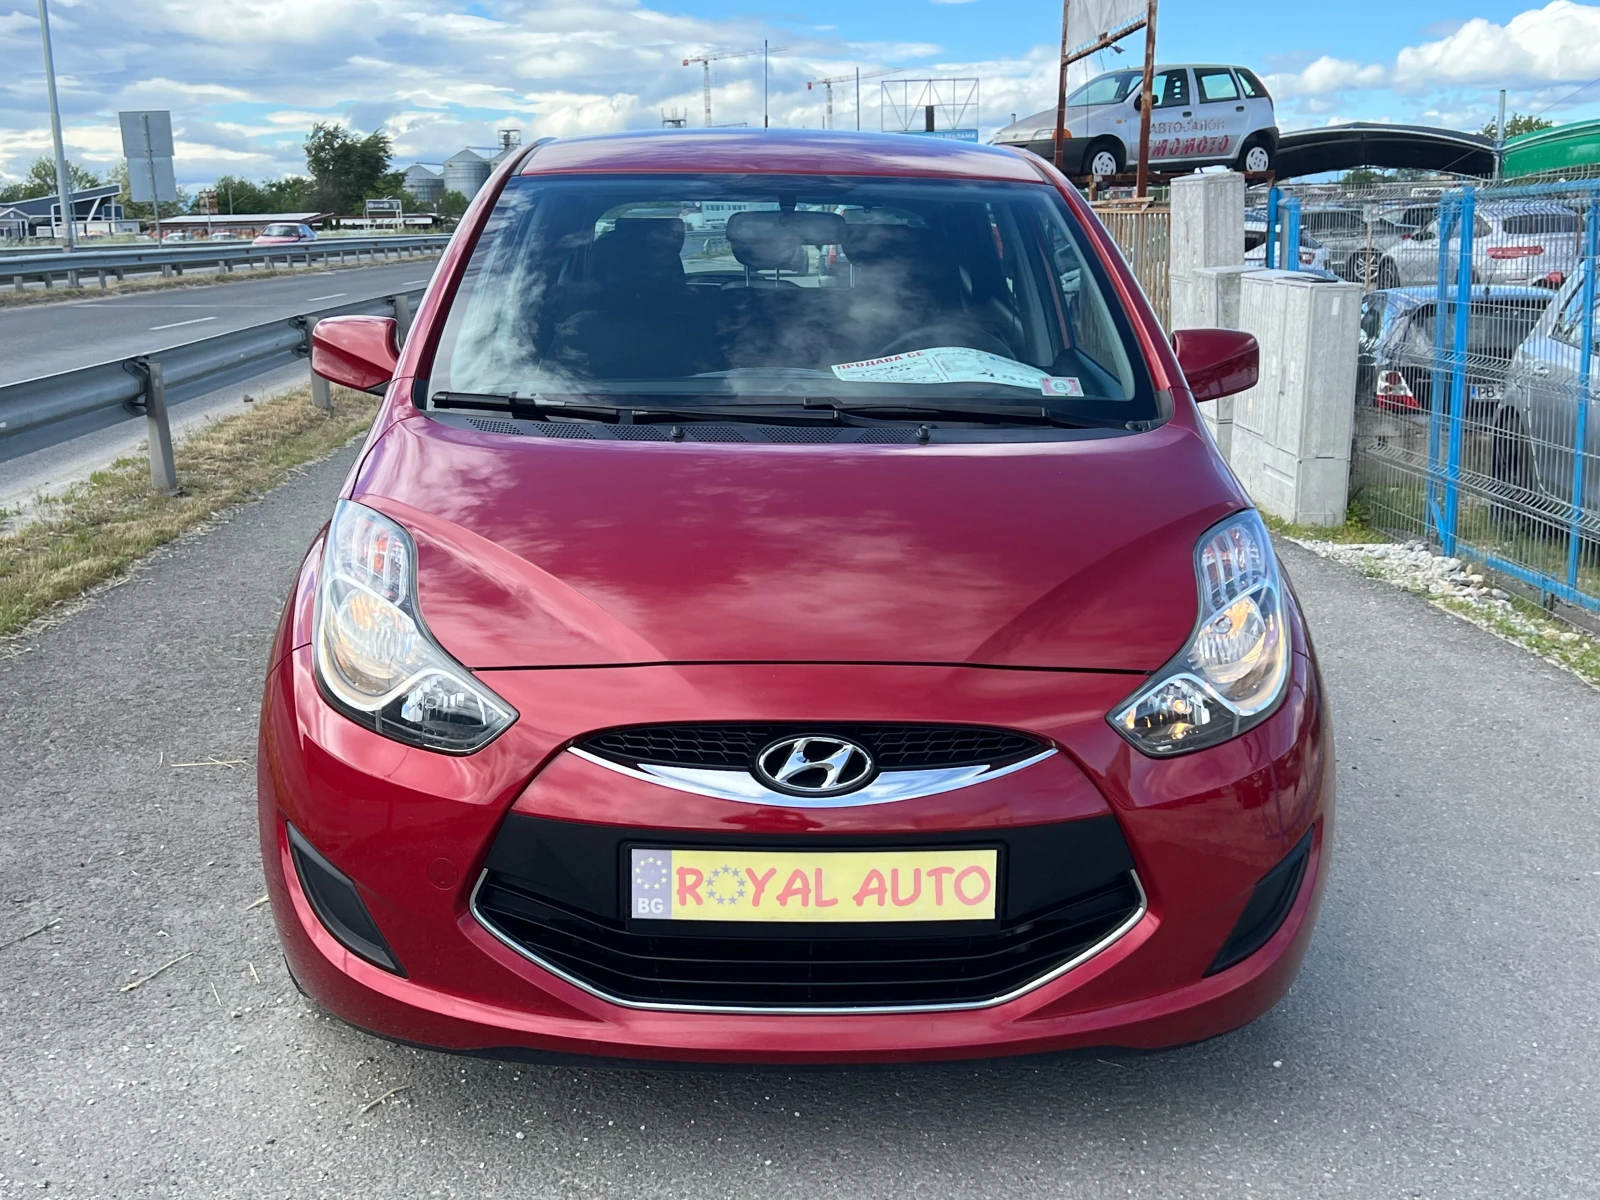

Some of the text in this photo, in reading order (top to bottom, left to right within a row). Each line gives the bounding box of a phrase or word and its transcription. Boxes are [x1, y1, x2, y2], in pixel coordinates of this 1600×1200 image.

[837, 355, 903, 370] ПРОДАВА
[852, 865, 992, 908] AUTO
[637, 897, 664, 914] BG
